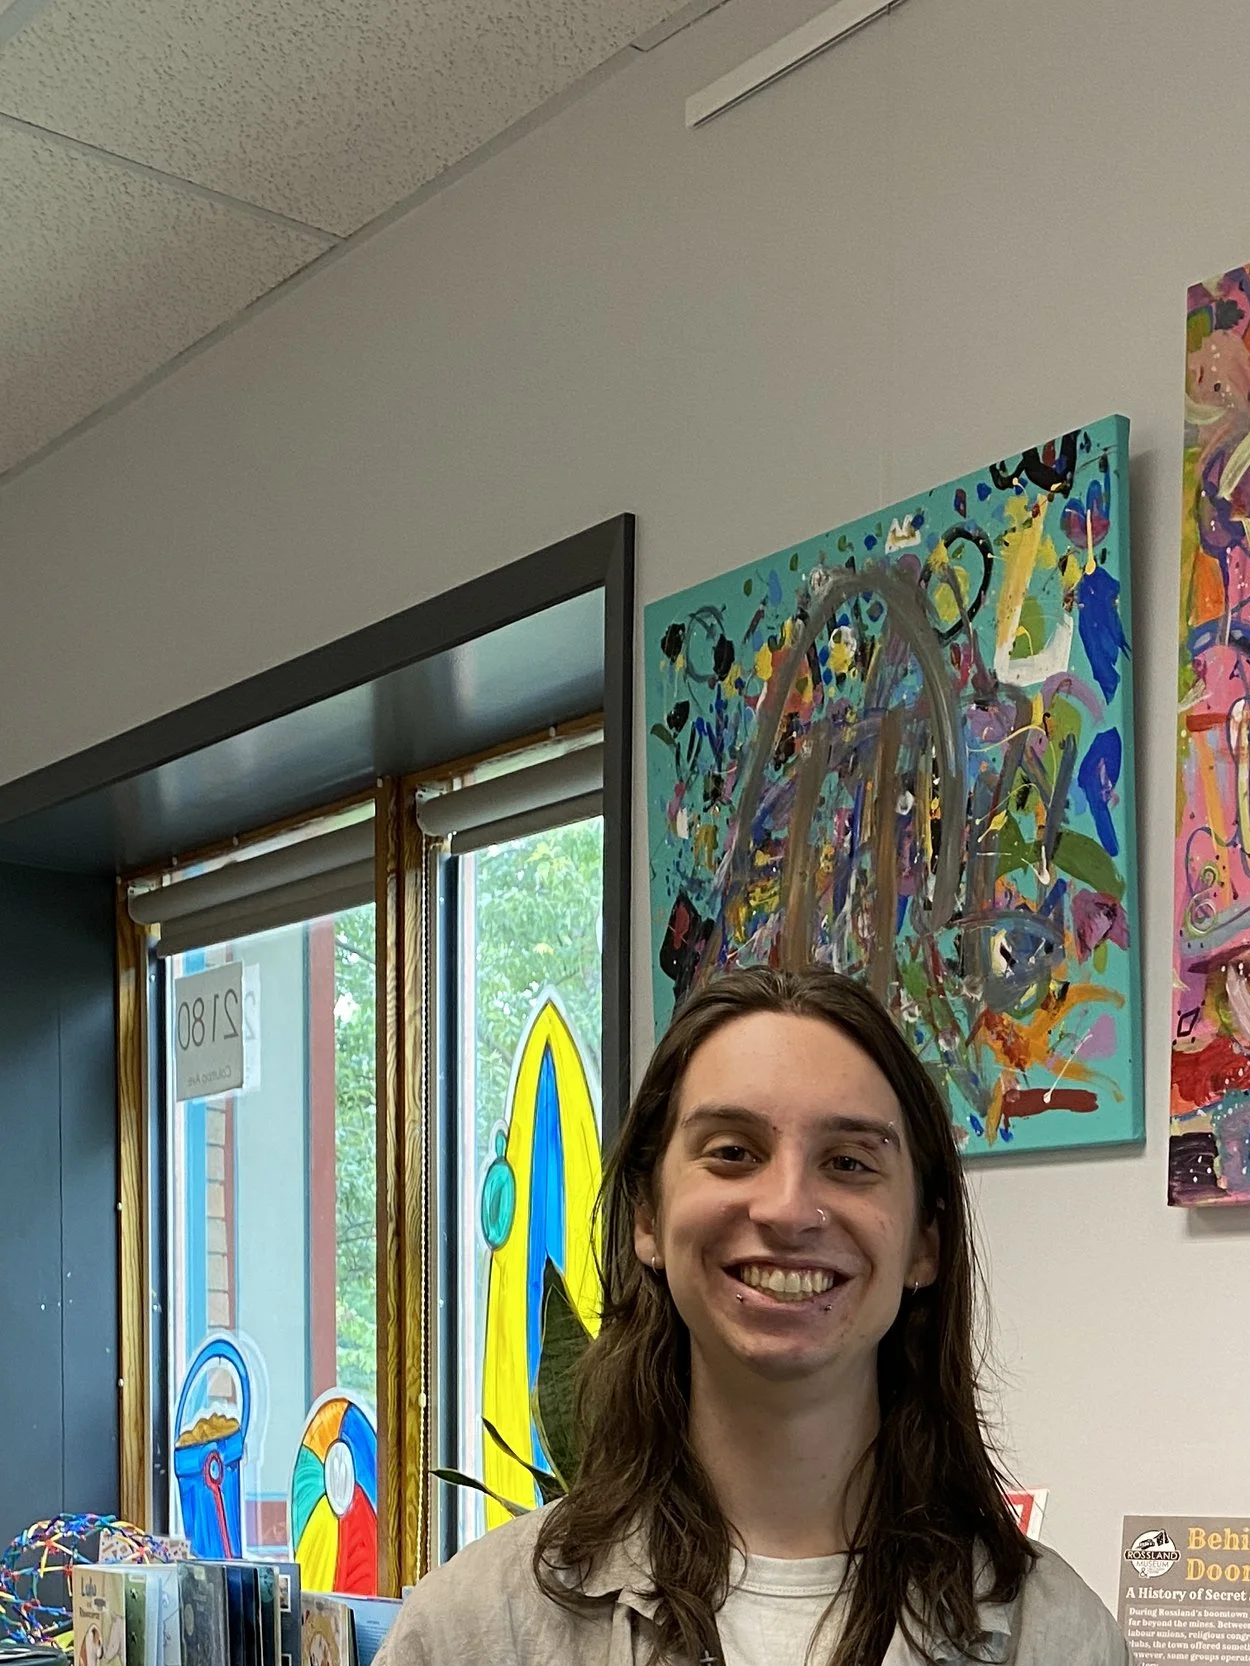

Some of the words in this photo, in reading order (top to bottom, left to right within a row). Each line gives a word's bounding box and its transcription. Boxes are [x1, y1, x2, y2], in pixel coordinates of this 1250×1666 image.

[1128, 1552, 1178, 1560] ROSSLAND
[1126, 1588, 1136, 1599] A
[1139, 1588, 1186, 1602] History
[1190, 1588, 1204, 1600] of
[1205, 1589, 1246, 1601] Secret
[1129, 1607, 1157, 1618] During
[1158, 1608, 1202, 1617] Rossland's
[1203, 1609, 1248, 1619] boomtown
[1128, 1618, 1140, 1626] far
[1141, 1618, 1172, 1629] beyond
[1173, 1619, 1187, 1628] the
[1188, 1619, 1215, 1629] mines.
[1127, 1628, 1155, 1638] labour
[1156, 1629, 1187, 1640] unions,
[1188, 1630, 1225, 1641] religious
